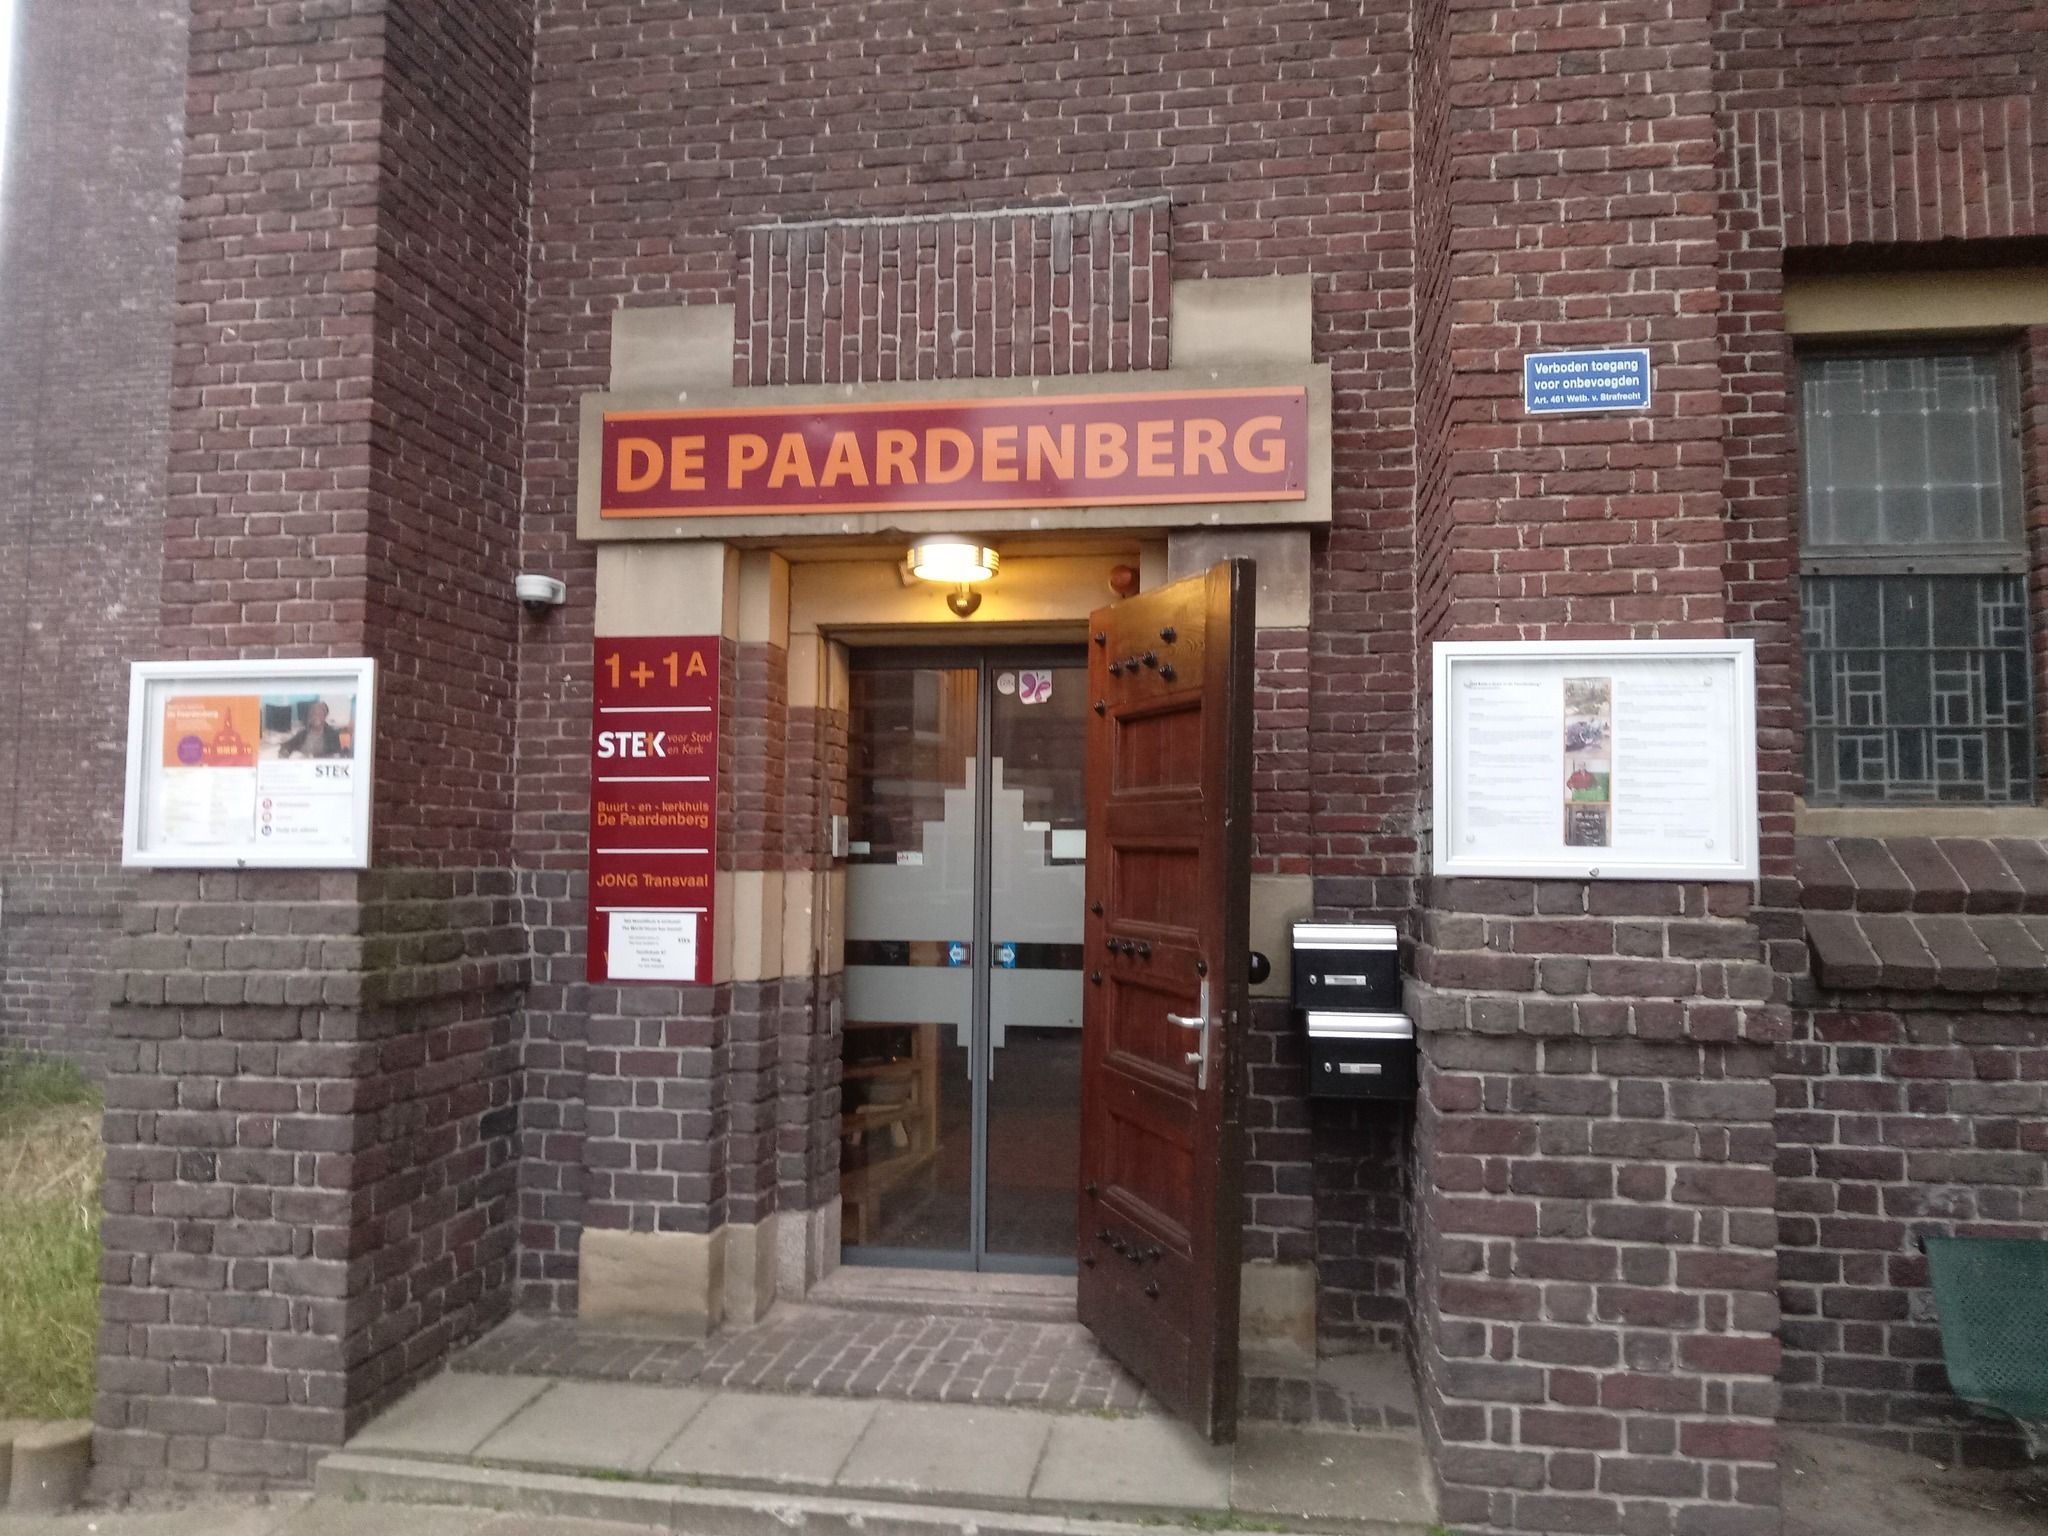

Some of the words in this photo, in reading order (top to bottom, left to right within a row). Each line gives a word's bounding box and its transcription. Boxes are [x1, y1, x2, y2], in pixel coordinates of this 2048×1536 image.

[1535, 361, 1589, 374] Verboden
[1591, 360, 1638, 373] toegang
[1534, 379, 1559, 390] voor
[1563, 376, 1640, 389] onbevoegden
[1534, 396, 1549, 404] Art.
[1567, 393, 1590, 402] Wetb.
[1600, 392, 1641, 401] Strafrecht
[616, 436, 706, 493] DE
[727, 416, 1287, 490] PAARDENBERG
[667, 735, 688, 743] voor
[690, 731, 712, 743] Stad
[597, 731, 666, 758] STEK
[667, 747, 679, 755] en
[682, 745, 704, 754] Kerk
[315, 765, 350, 778] STEK
[598, 801, 628, 812] Buurt
[639, 803, 652, 812] en
[662, 801, 709, 812] kerkhuis
[597, 812, 616, 826] De
[620, 812, 709, 829] Paardenberg
[596, 873, 638, 888] JONG
[642, 873, 708, 888] Transvaal
